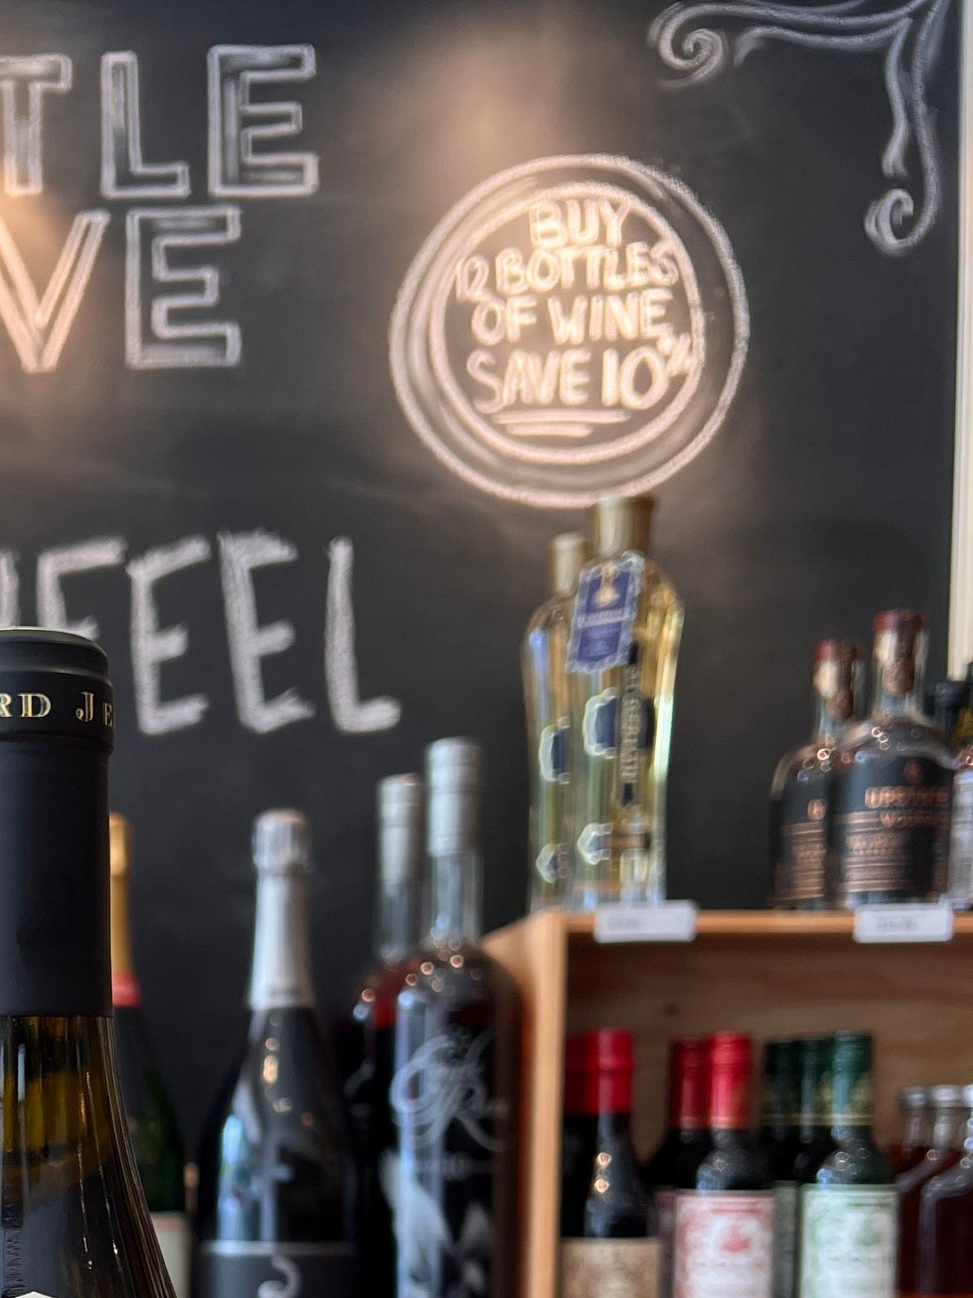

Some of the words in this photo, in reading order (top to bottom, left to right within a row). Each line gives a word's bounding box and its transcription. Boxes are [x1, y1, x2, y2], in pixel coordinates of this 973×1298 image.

[528, 199, 631, 249] BUY
[495, 242, 681, 296] BOTTLES
[471, 296, 538, 347] OF
[547, 290, 675, 345] WINE
[465, 347, 592, 414] SAVE
